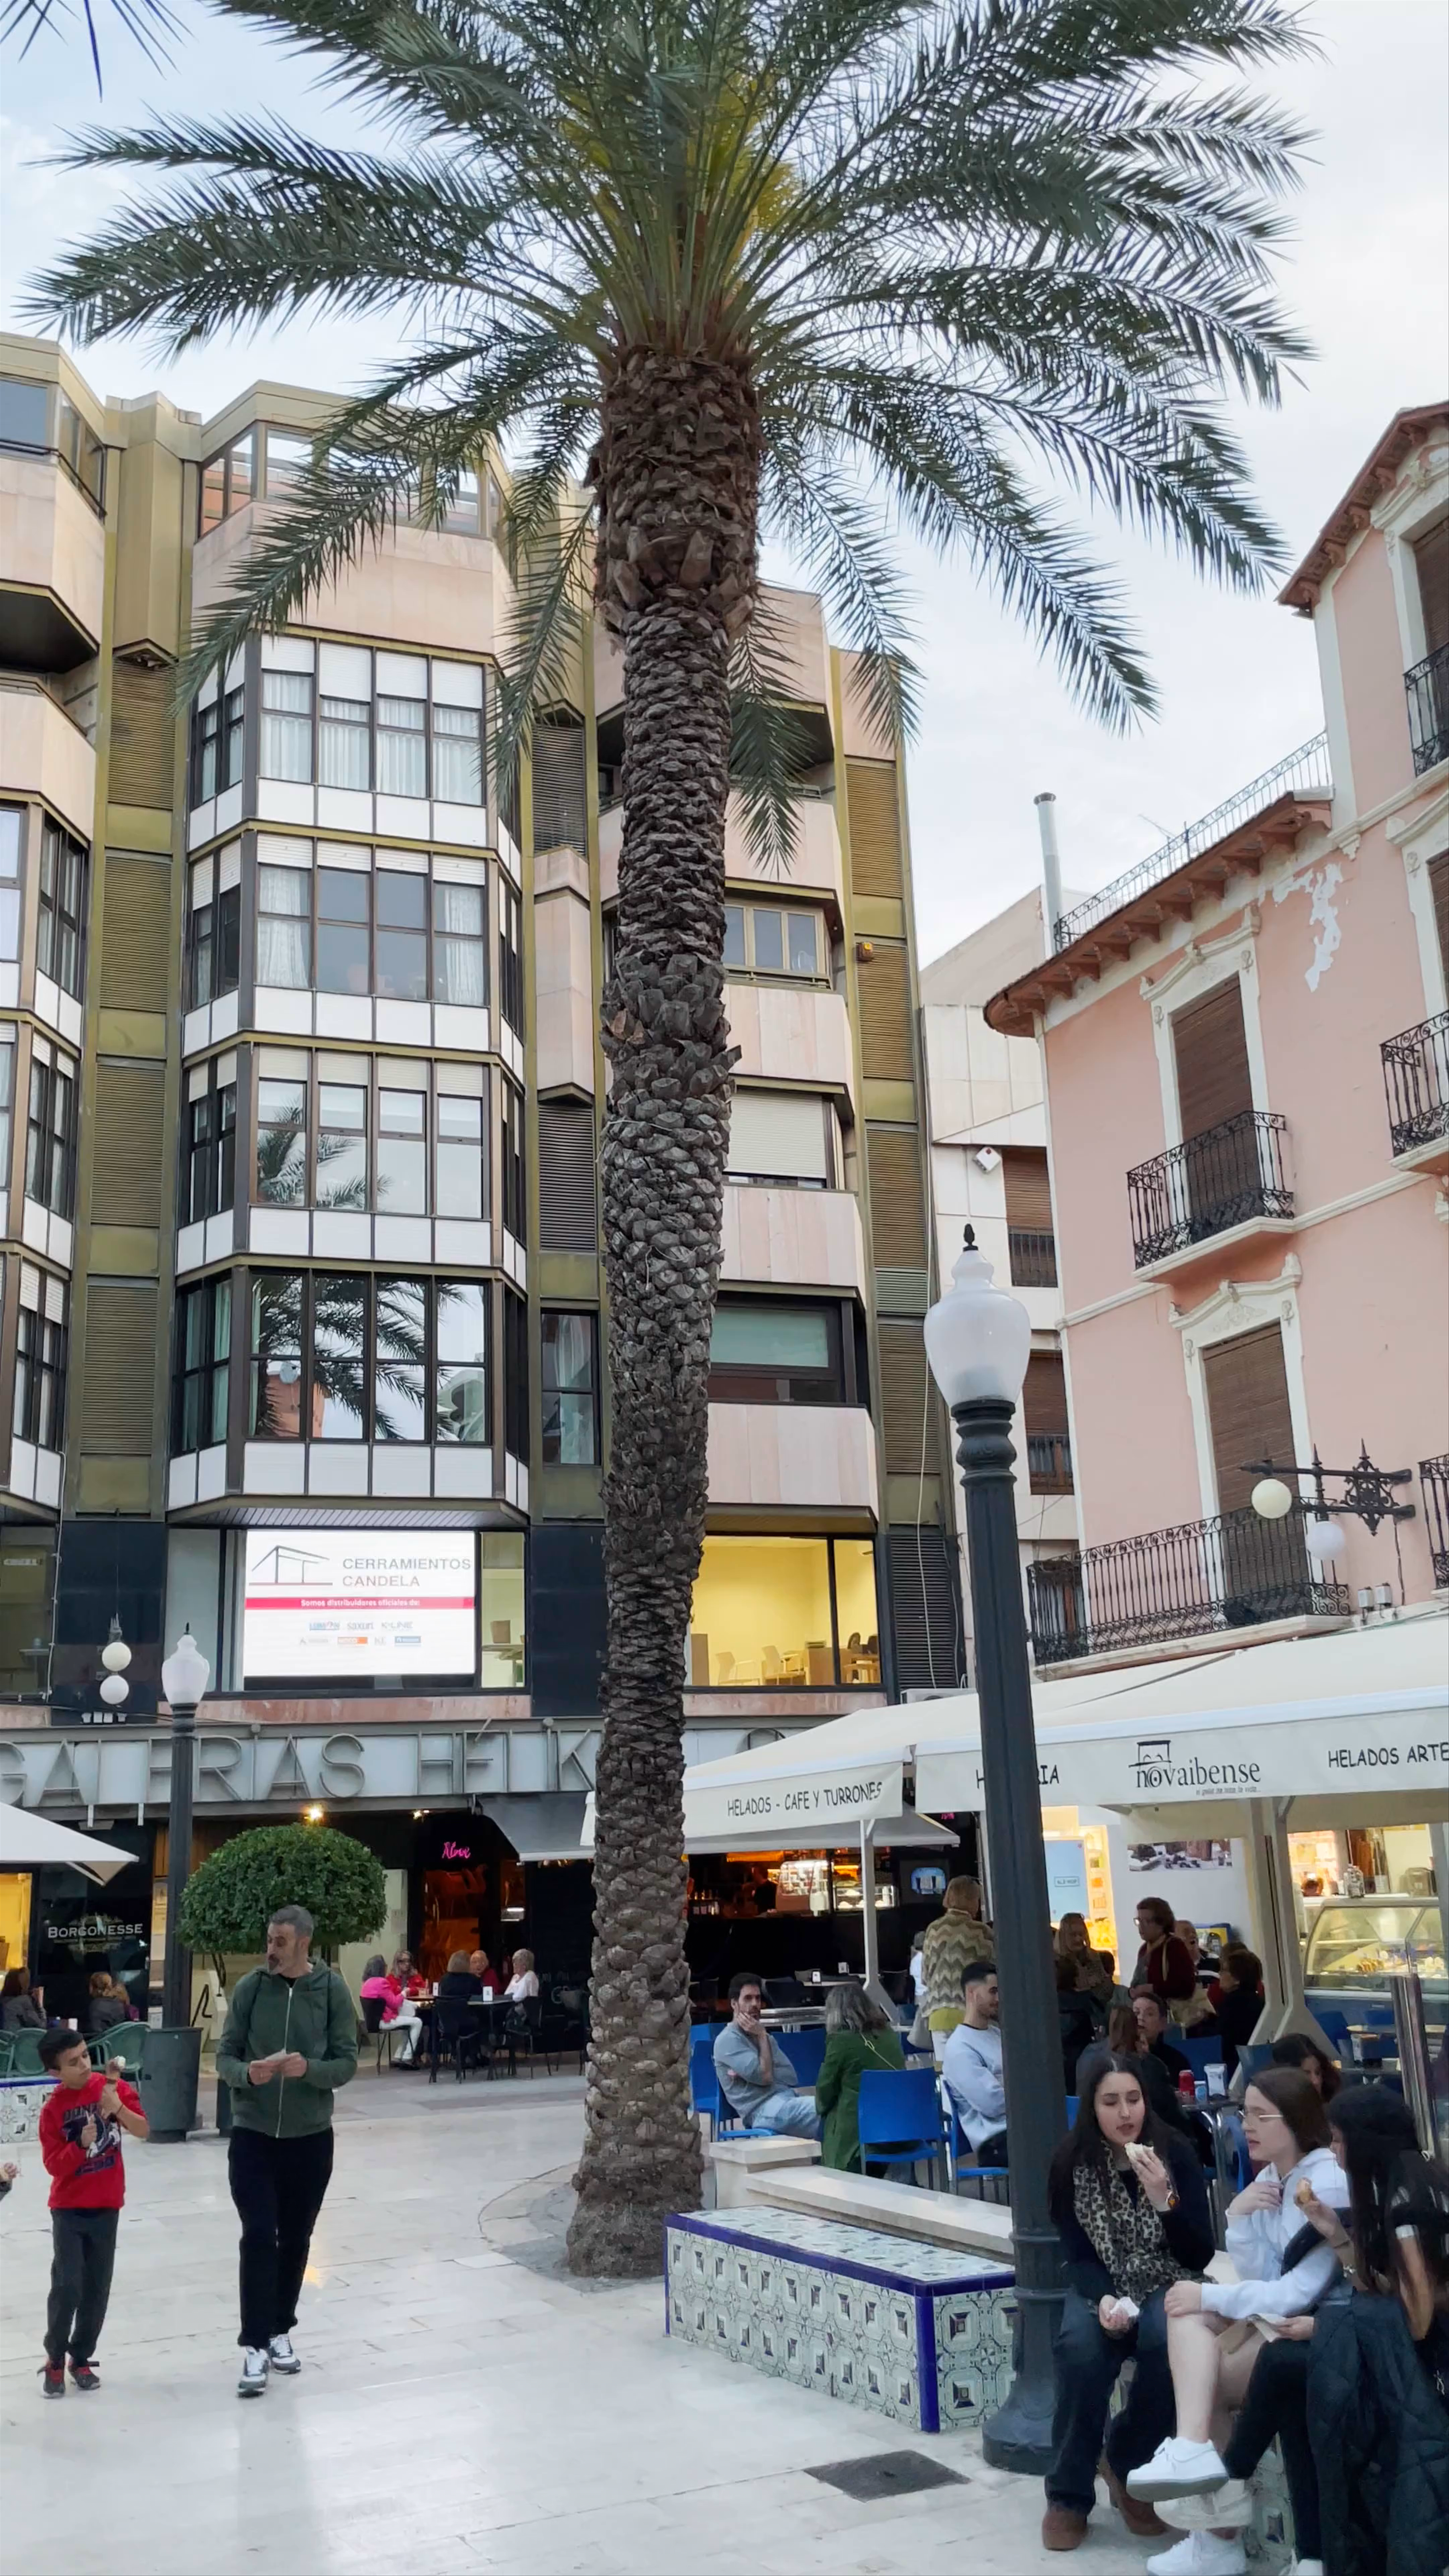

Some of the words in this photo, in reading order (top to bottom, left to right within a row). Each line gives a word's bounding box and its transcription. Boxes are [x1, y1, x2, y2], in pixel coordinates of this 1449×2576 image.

[343, 1558, 471, 1569] CERRAMIENTOS
[343, 1575, 420, 1587] CANDELA
[1328, 1747, 1399, 1768] HELADOS
[1407, 1742, 1449, 1763] ARTE
[1137, 1757, 1261, 1788] novaibense
[728, 1797, 771, 1816] HELADOS
[784, 1791, 810, 1810] CAFE
[813, 1790, 820, 1808] Y
[824, 1781, 883, 1806] TURRONES
[48, 1924, 143, 1938] BORGONESSE
